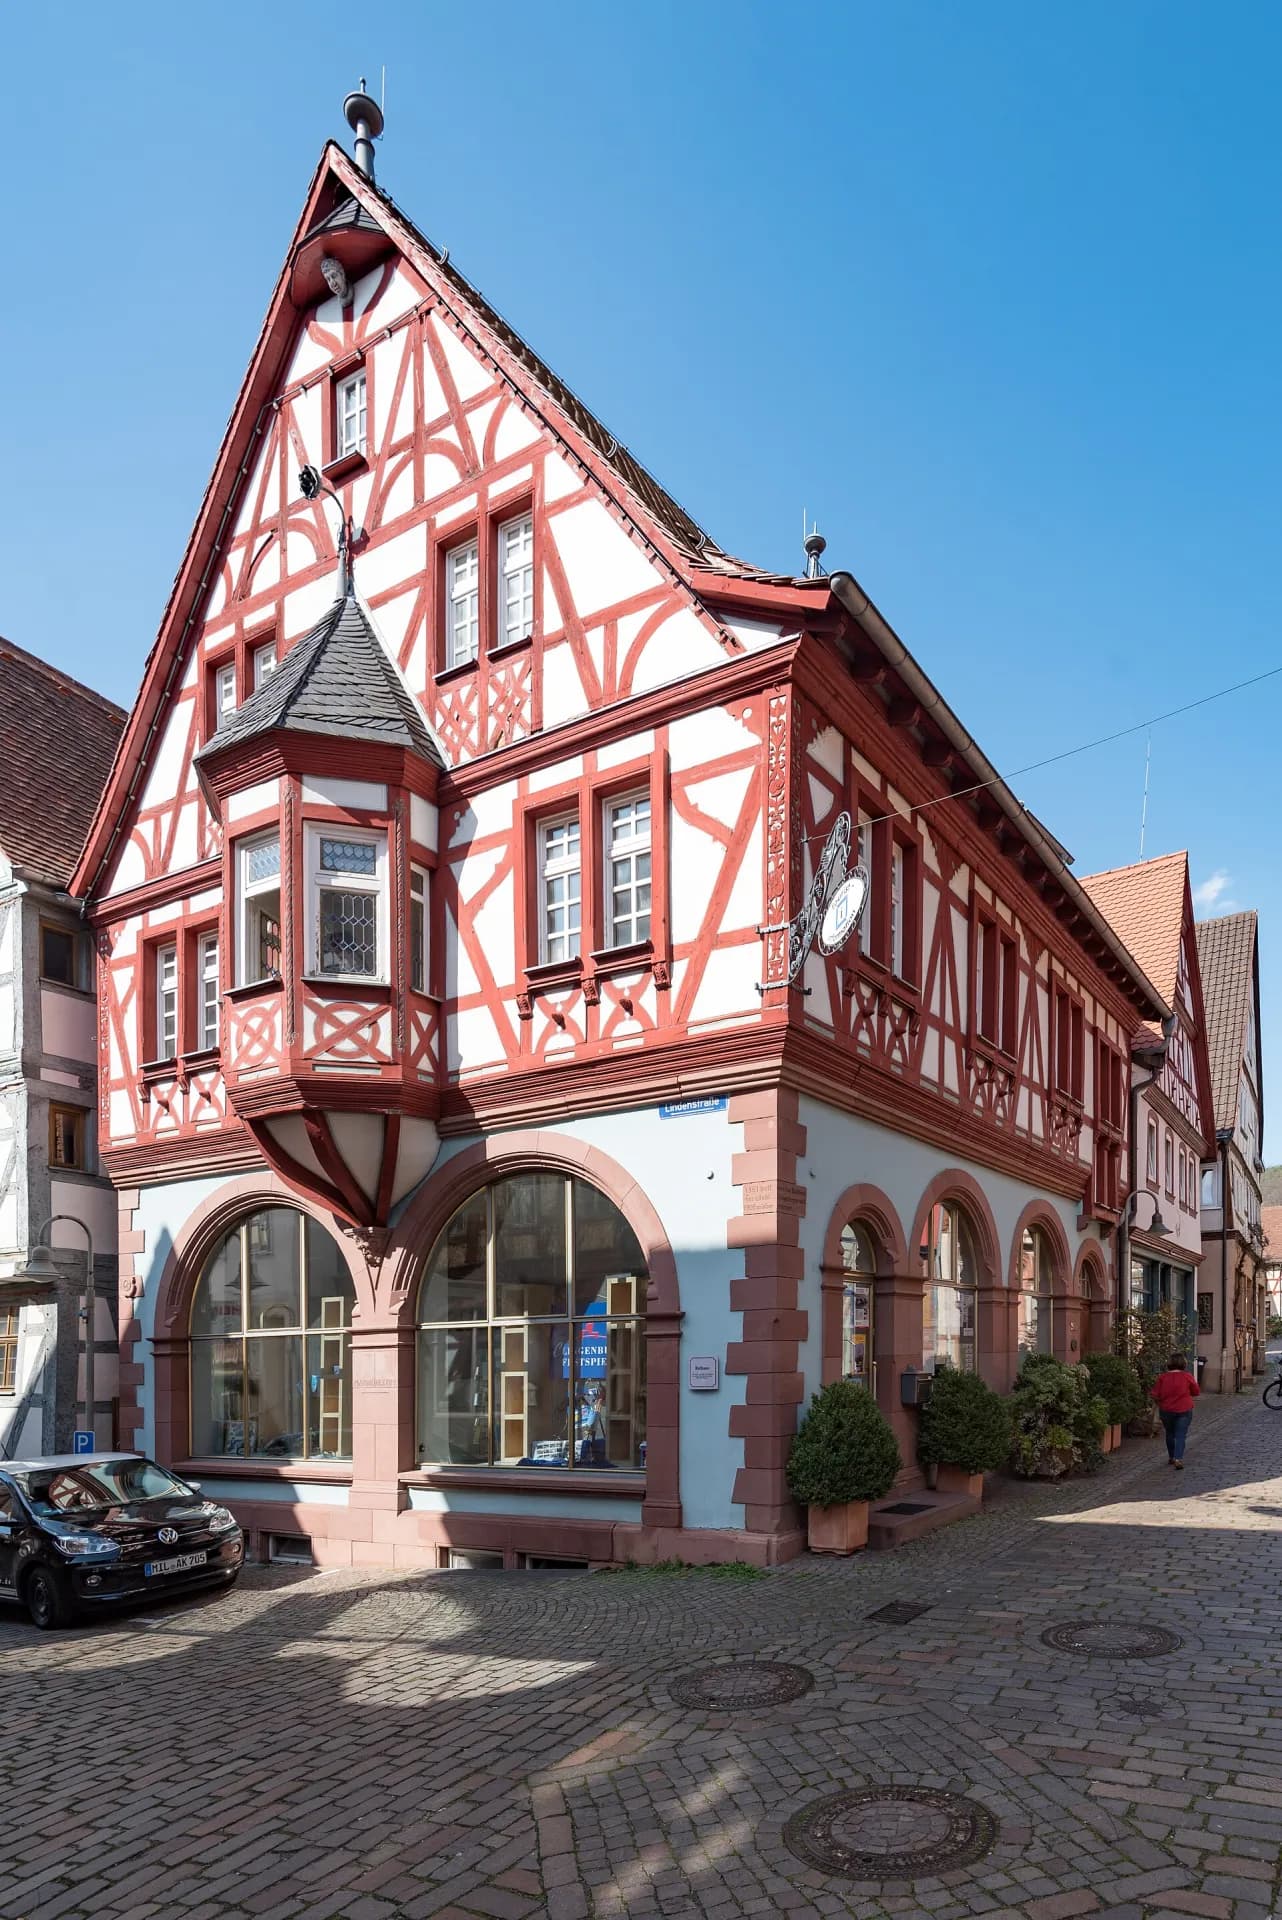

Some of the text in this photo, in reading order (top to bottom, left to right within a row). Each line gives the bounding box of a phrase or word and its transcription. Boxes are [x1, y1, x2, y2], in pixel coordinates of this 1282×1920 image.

[665, 1096, 720, 1113] Lindenstraße
[78, 1434, 89, 1453] P
[152, 1553, 205, 1574] MIL AK 705
